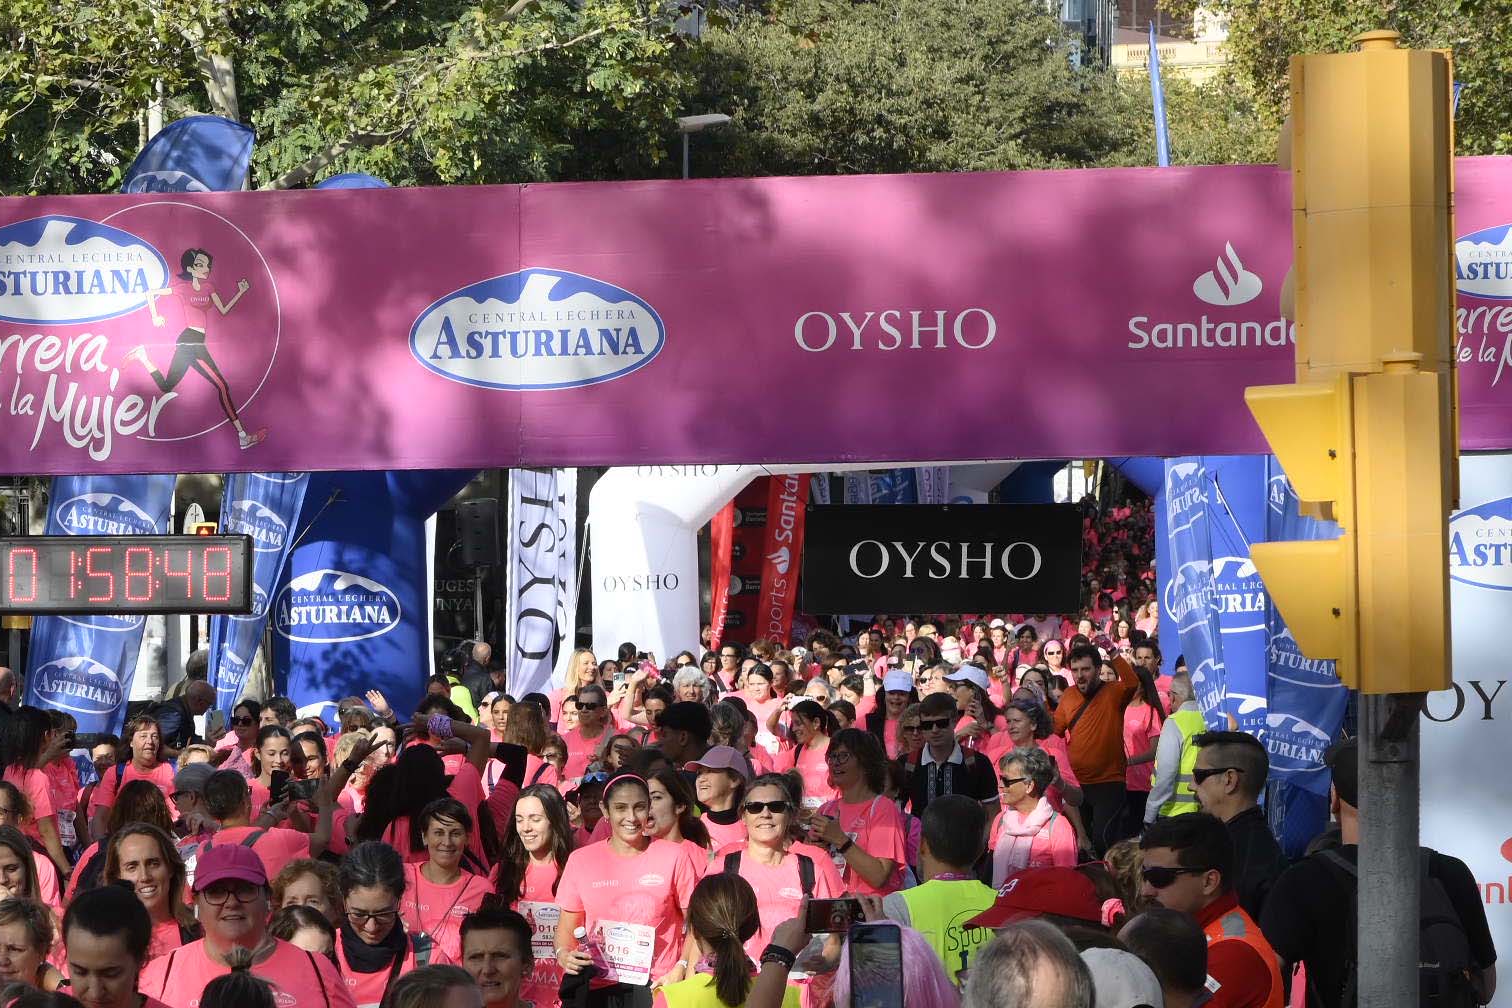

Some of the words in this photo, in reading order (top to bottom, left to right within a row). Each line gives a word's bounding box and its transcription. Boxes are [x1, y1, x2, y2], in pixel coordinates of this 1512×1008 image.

[72, 252, 144, 263] LECHERA
[469, 311, 548, 324] CENTRAL
[555, 308, 637, 322] LECHERA
[794, 308, 997, 352] OYSHO
[1127, 315, 1297, 350] Santand
[429, 317, 645, 359] ASTURIANA
[10, 376, 35, 415] la
[29, 367, 178, 461] Mujer
[8, 546, 232, 602] 01:58:48
[849, 539, 1043, 580] OYSHO
[292, 595, 334, 604] CENTRAL
[338, 593, 388, 603] LECHERA
[602, 572, 679, 592] OYSHO
[280, 600, 392, 626] ASTURIANA
[37, 671, 117, 706] ASTURIANA
